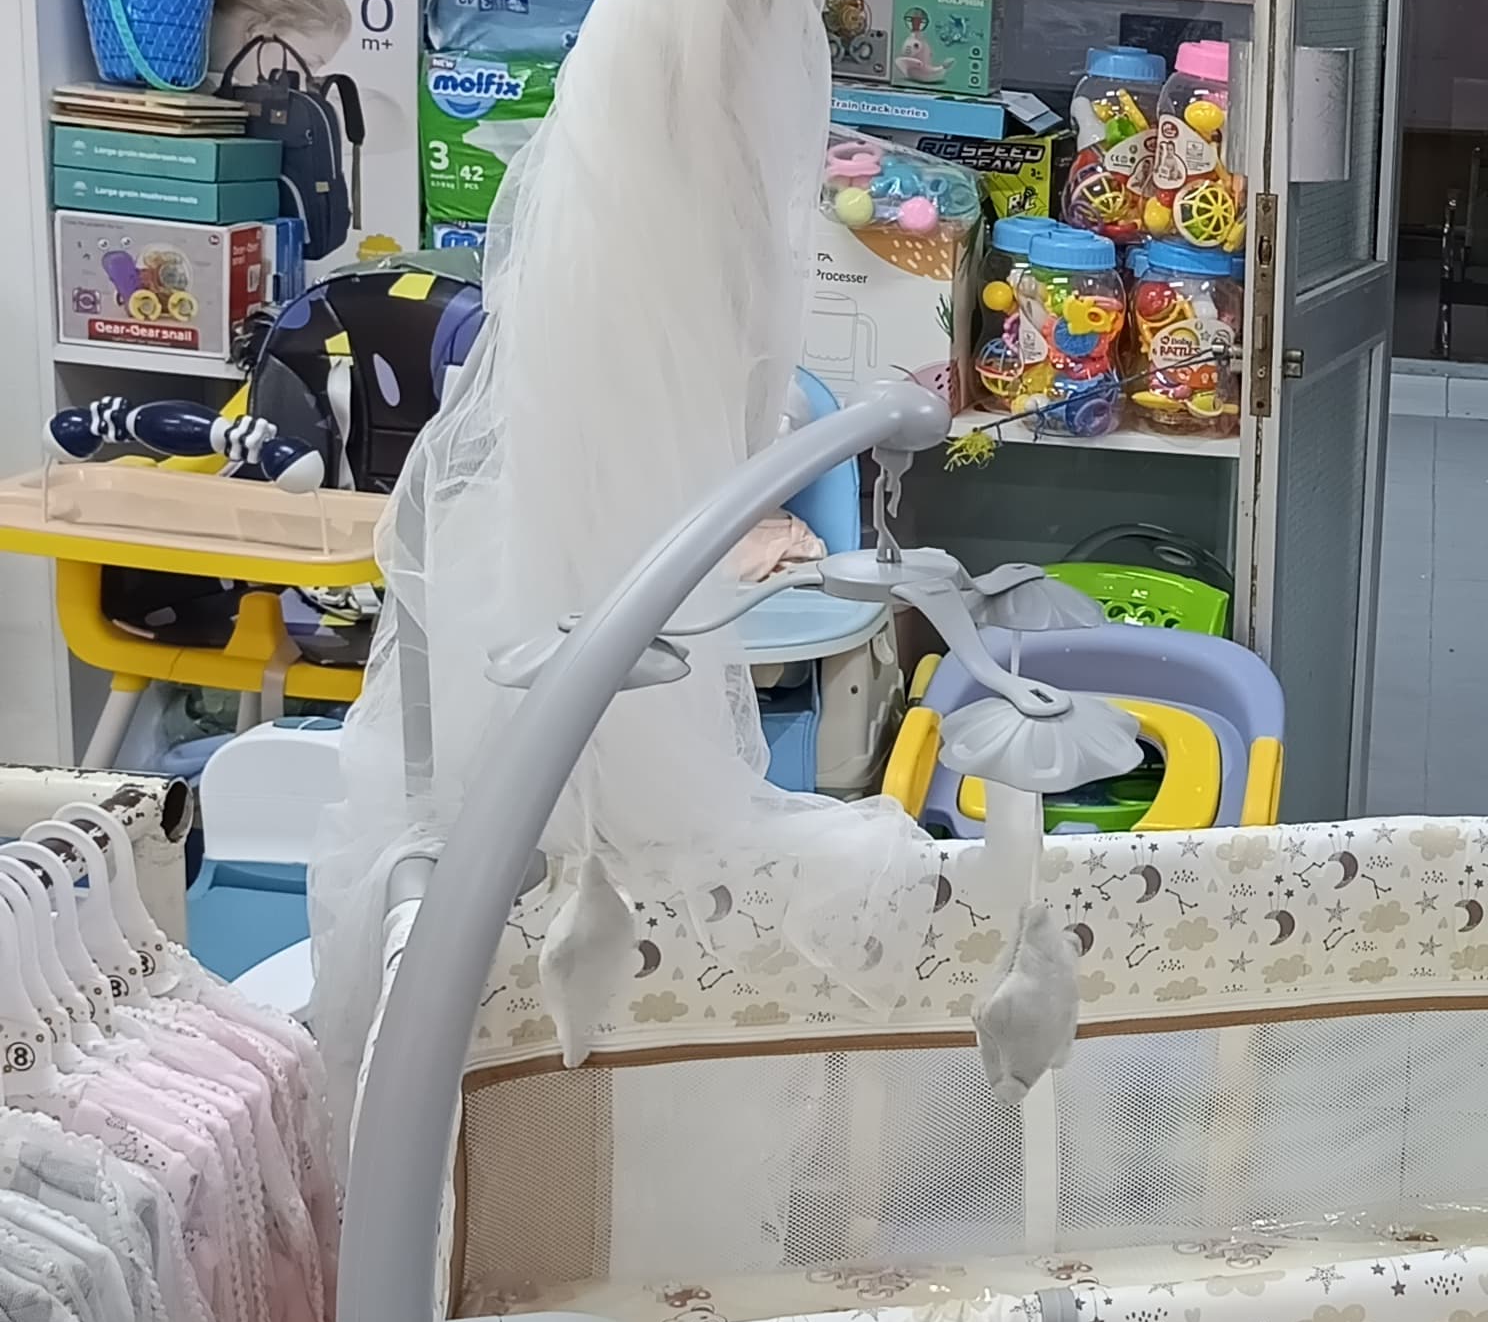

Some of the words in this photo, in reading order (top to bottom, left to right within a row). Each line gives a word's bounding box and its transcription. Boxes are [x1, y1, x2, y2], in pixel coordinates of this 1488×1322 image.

[362, 38, 393, 51] m+
[432, 58, 455, 69] NEW
[433, 71, 522, 98] molfix
[861, 101, 890, 113] track
[893, 106, 928, 118] series
[429, 141, 450, 170] 3
[961, 144, 1043, 160] SPEED
[460, 166, 484, 182] 42
[161, 327, 193, 341] snail
[1160, 346, 1200, 357] RATTLES
[14, 1046, 28, 1066] 8
